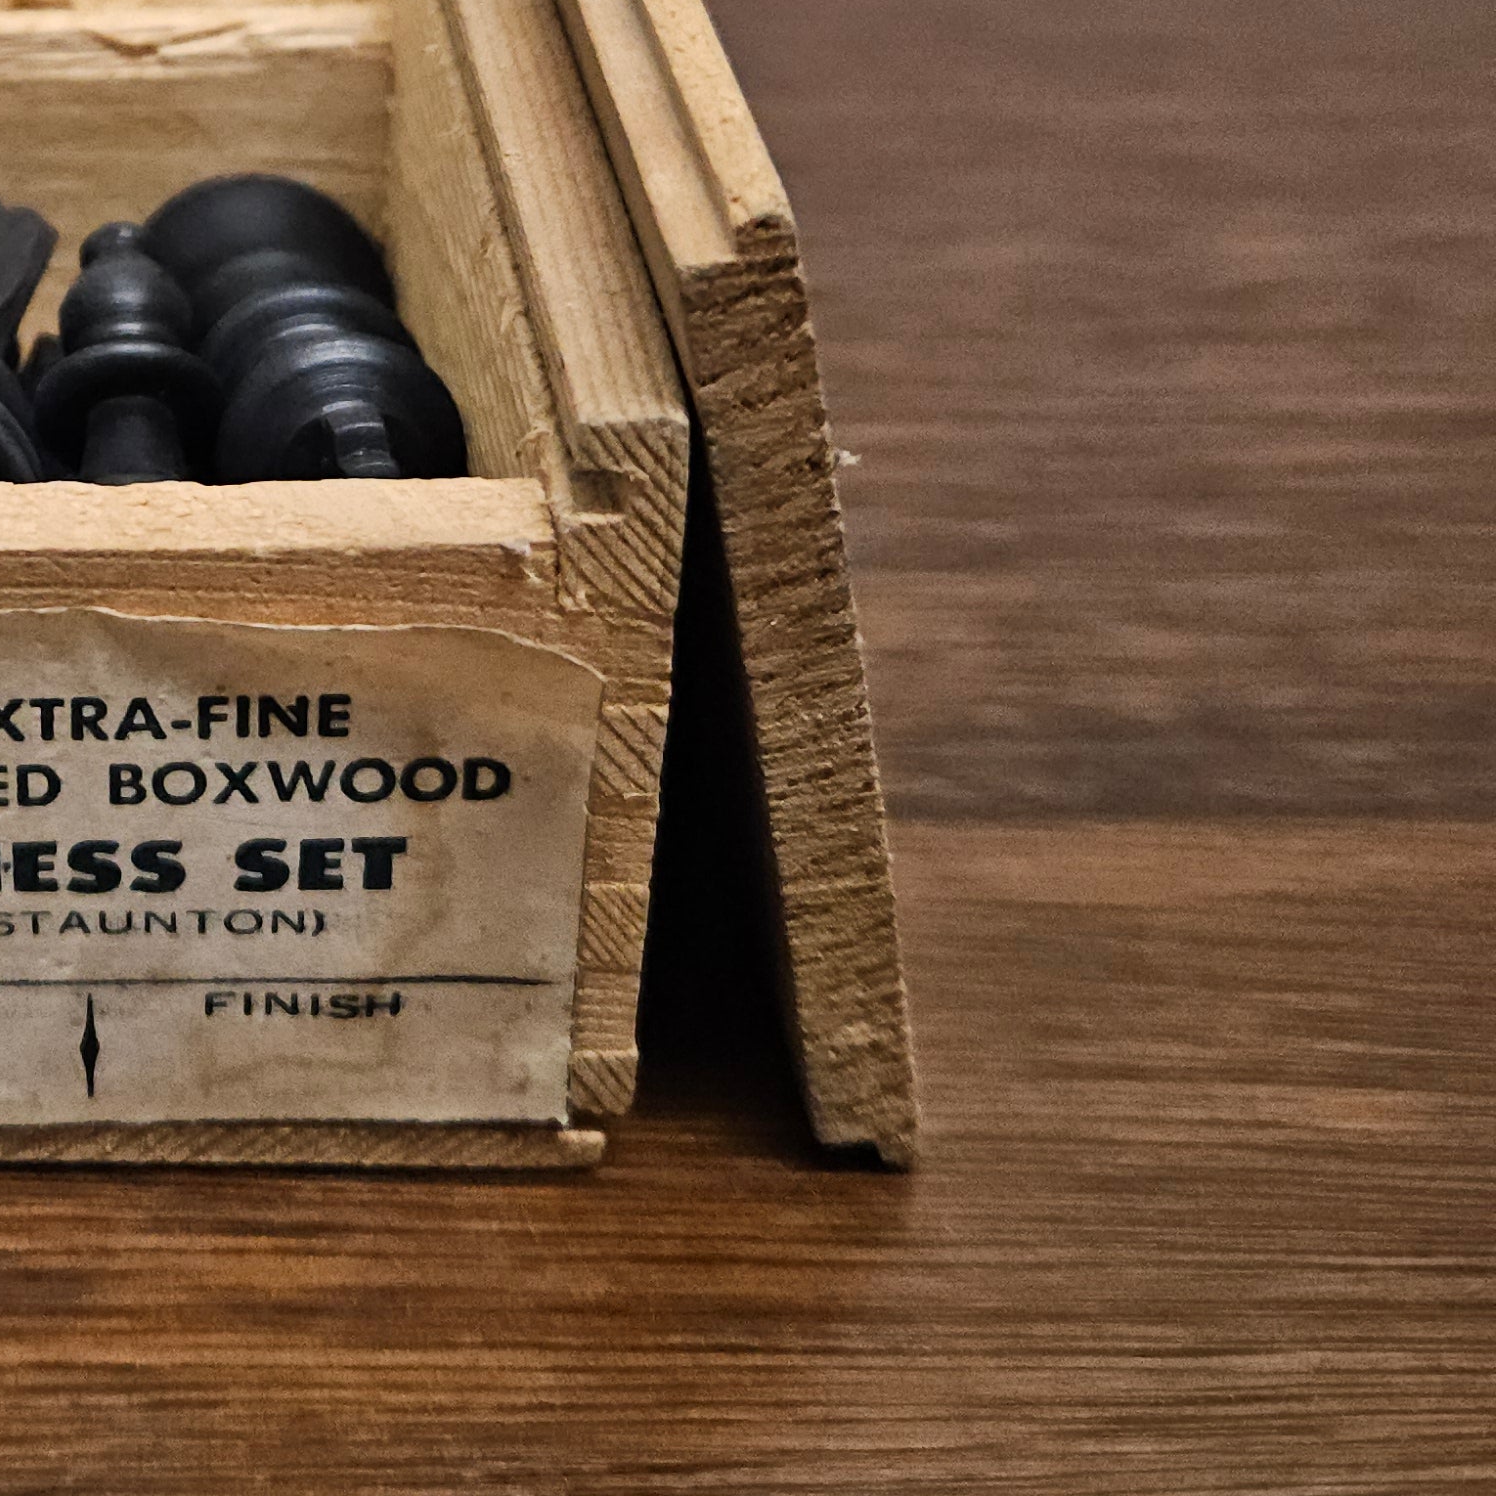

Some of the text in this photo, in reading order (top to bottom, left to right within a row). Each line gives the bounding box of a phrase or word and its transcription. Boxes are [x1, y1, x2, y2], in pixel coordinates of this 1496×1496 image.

[108, 757, 512, 806] BOXWOOD
[233, 836, 410, 893] SET
[203, 990, 404, 1018] FINISH
